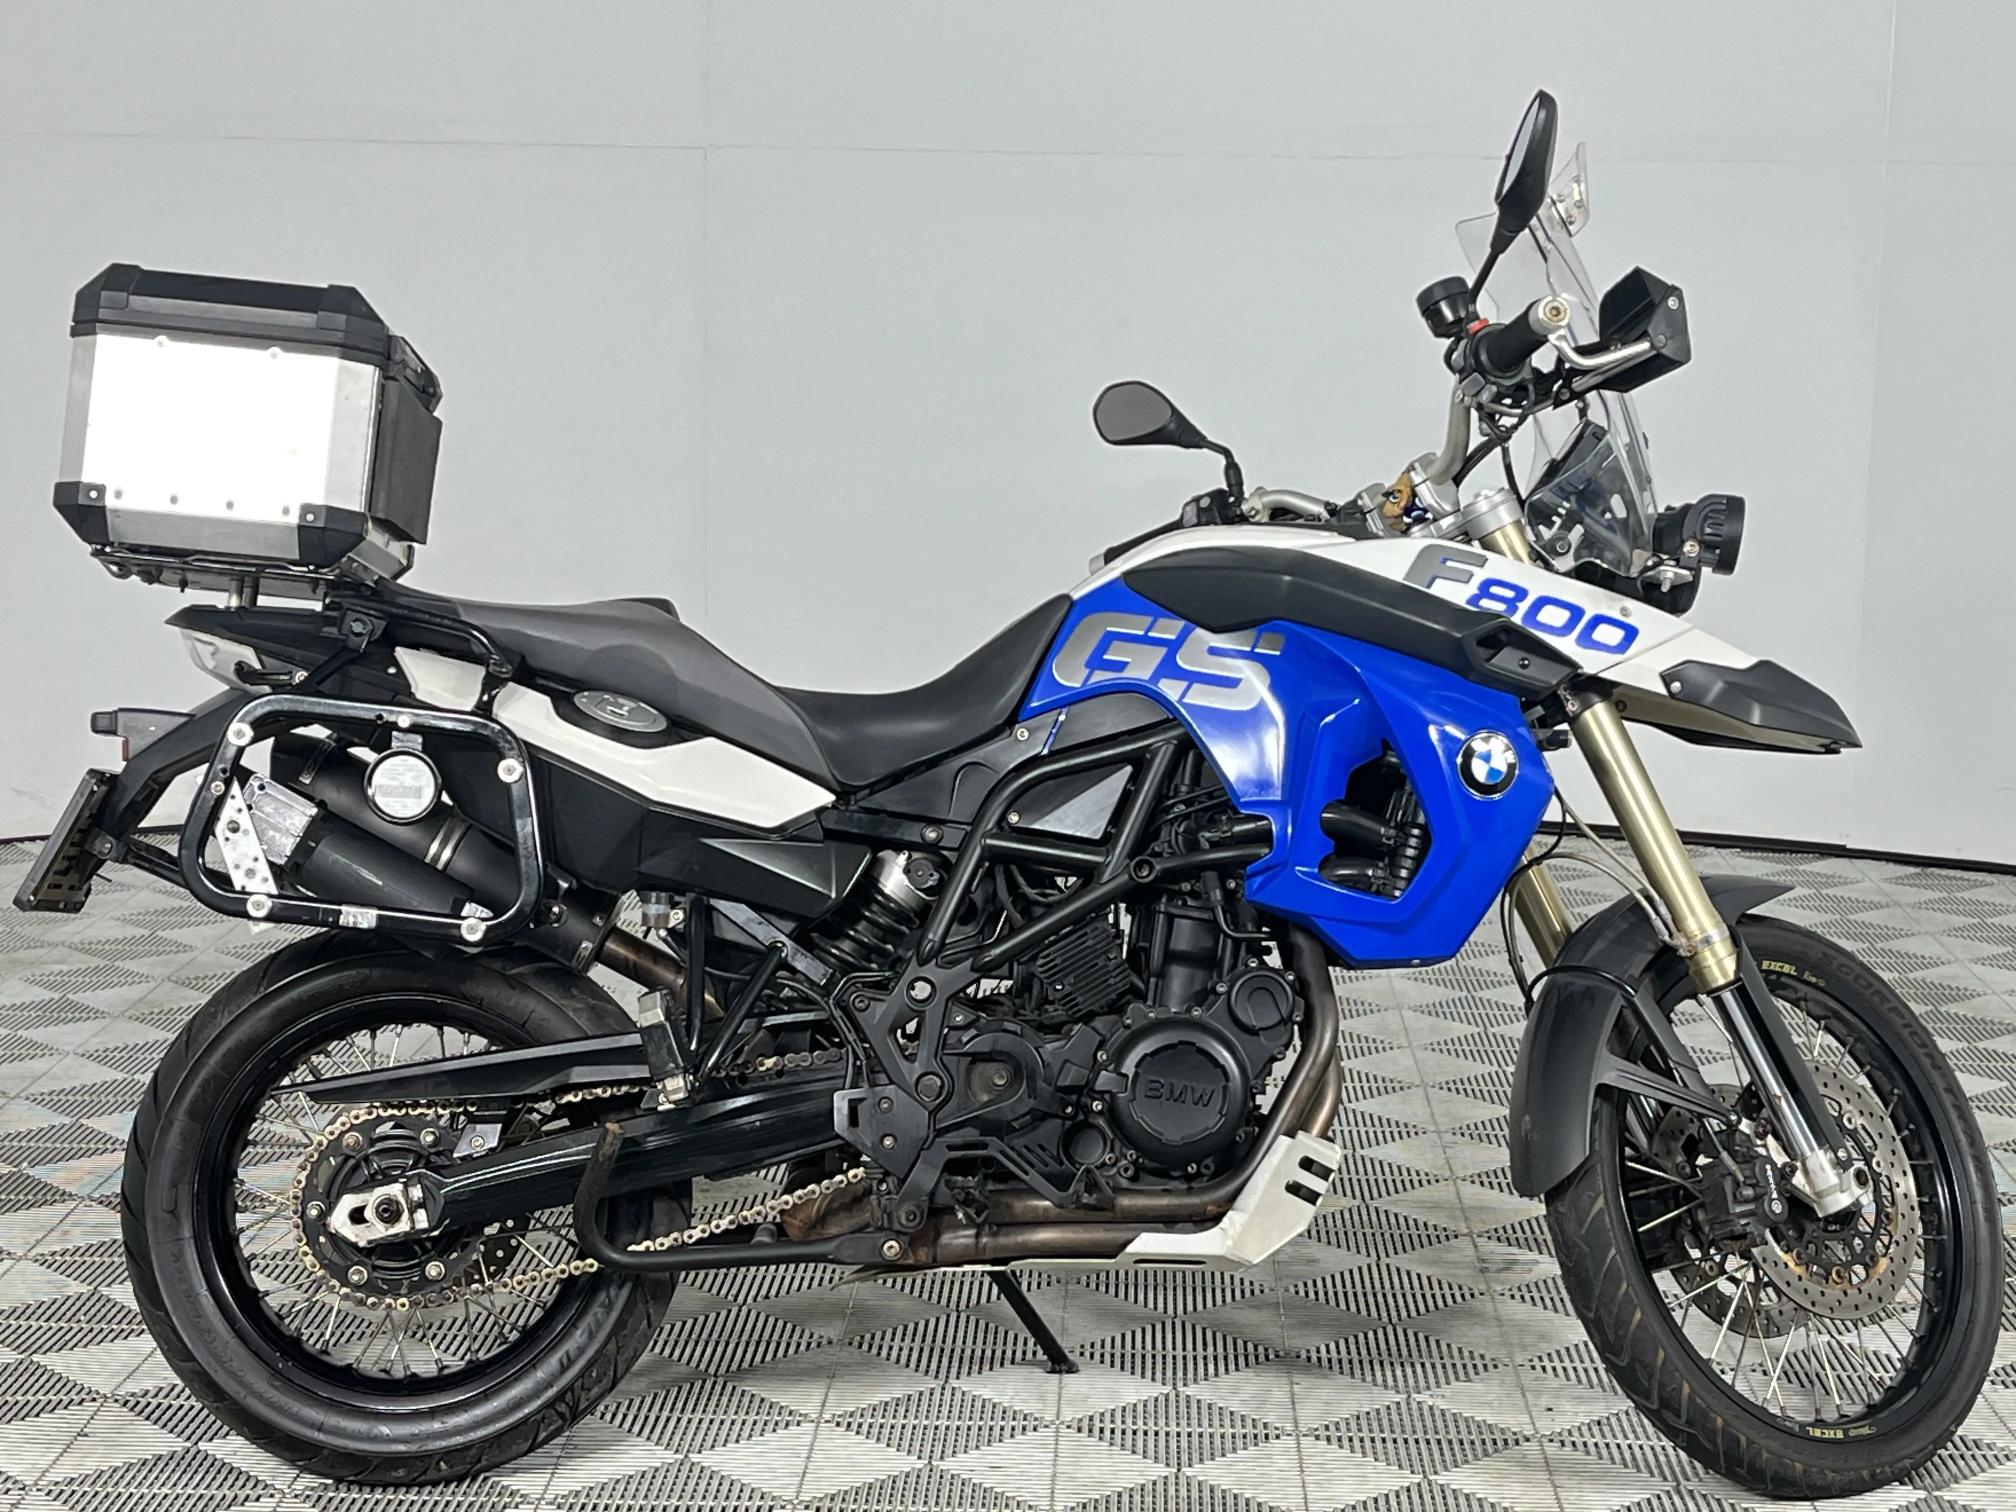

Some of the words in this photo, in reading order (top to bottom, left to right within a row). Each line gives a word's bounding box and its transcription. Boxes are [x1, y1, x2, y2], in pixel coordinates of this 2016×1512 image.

[1053, 612, 1286, 711] GS
[1761, 960, 1797, 976] EXCEL
[1820, 951, 1943, 1072] SCORPION
[1144, 1079, 1215, 1107] BMW
